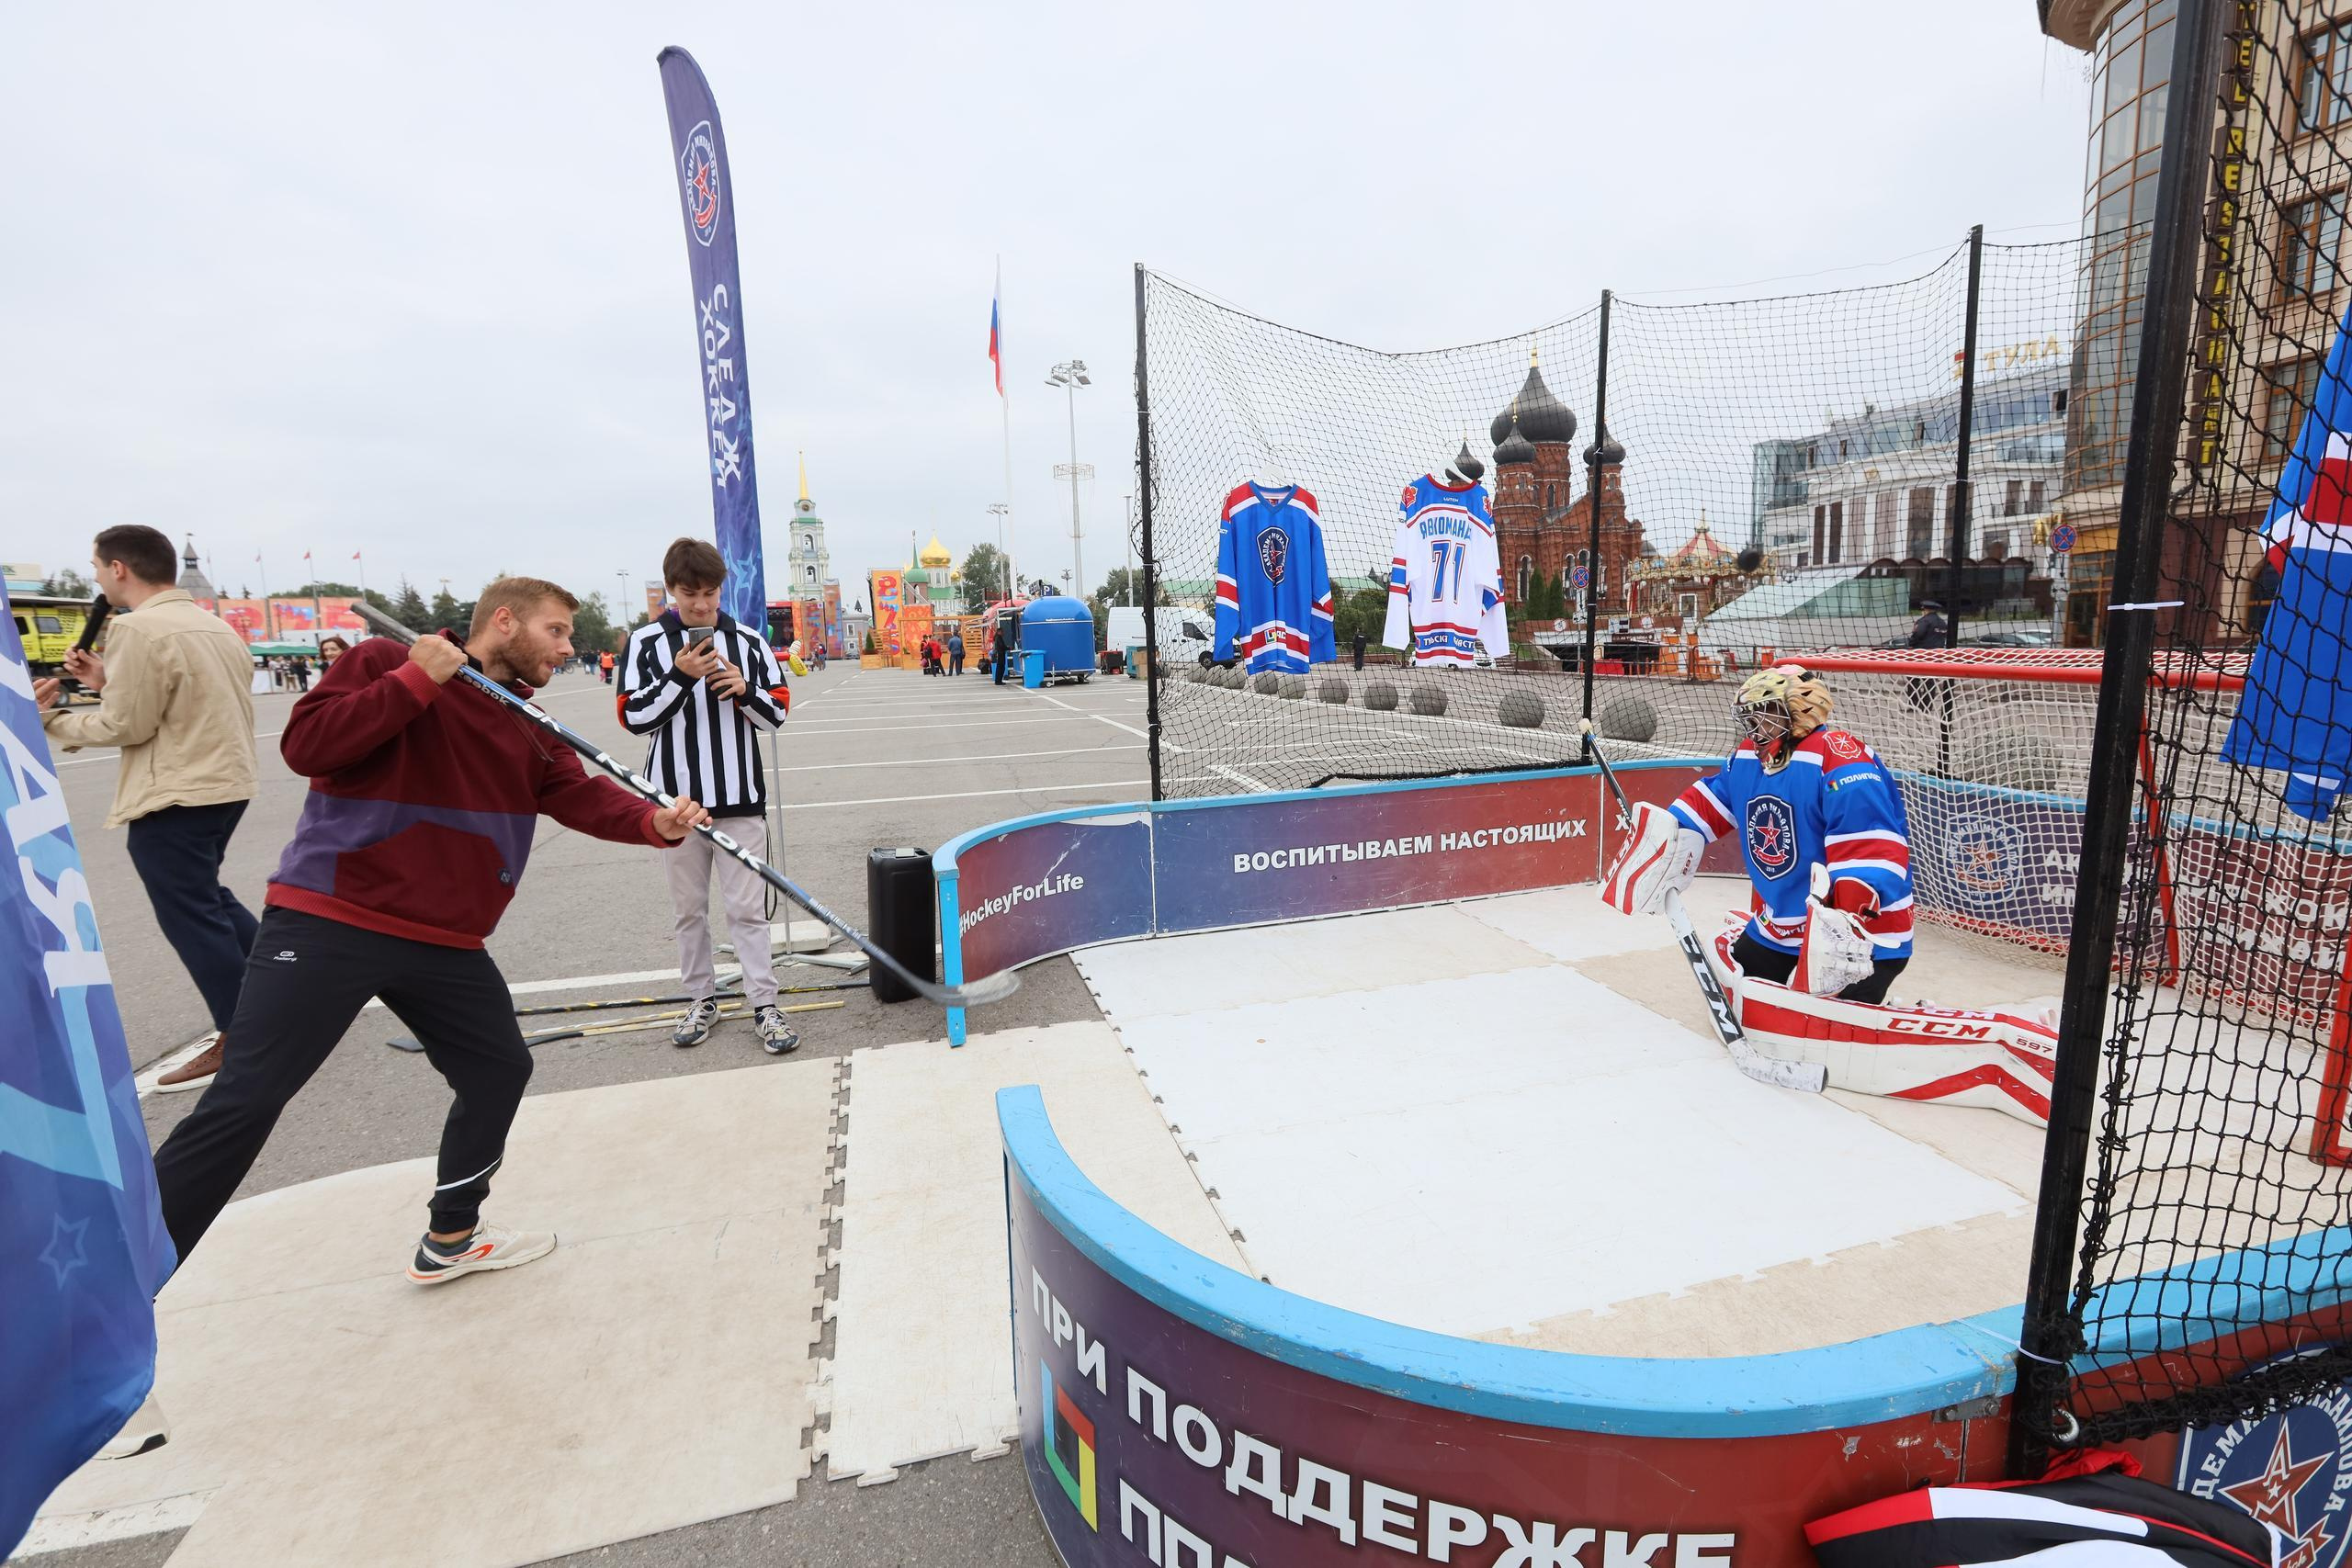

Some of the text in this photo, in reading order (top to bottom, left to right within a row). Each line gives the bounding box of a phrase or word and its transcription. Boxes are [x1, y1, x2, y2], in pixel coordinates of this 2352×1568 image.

[1983, 335, 2064, 373] ТУЛА
[1043, 585, 1051, 596] P
[1430, 539, 1466, 604] 71
[1233, 834, 1433, 874] ВОСПИТЫВАЕМ
[1440, 818, 1588, 852] НАСТОЯЩИХ
[1886, 1017, 1992, 1039] CCM
[2016, 1037, 2053, 1053] 597
[1032, 1265, 1736, 1568] ПРИ ПОДДЕРЖКЕ
